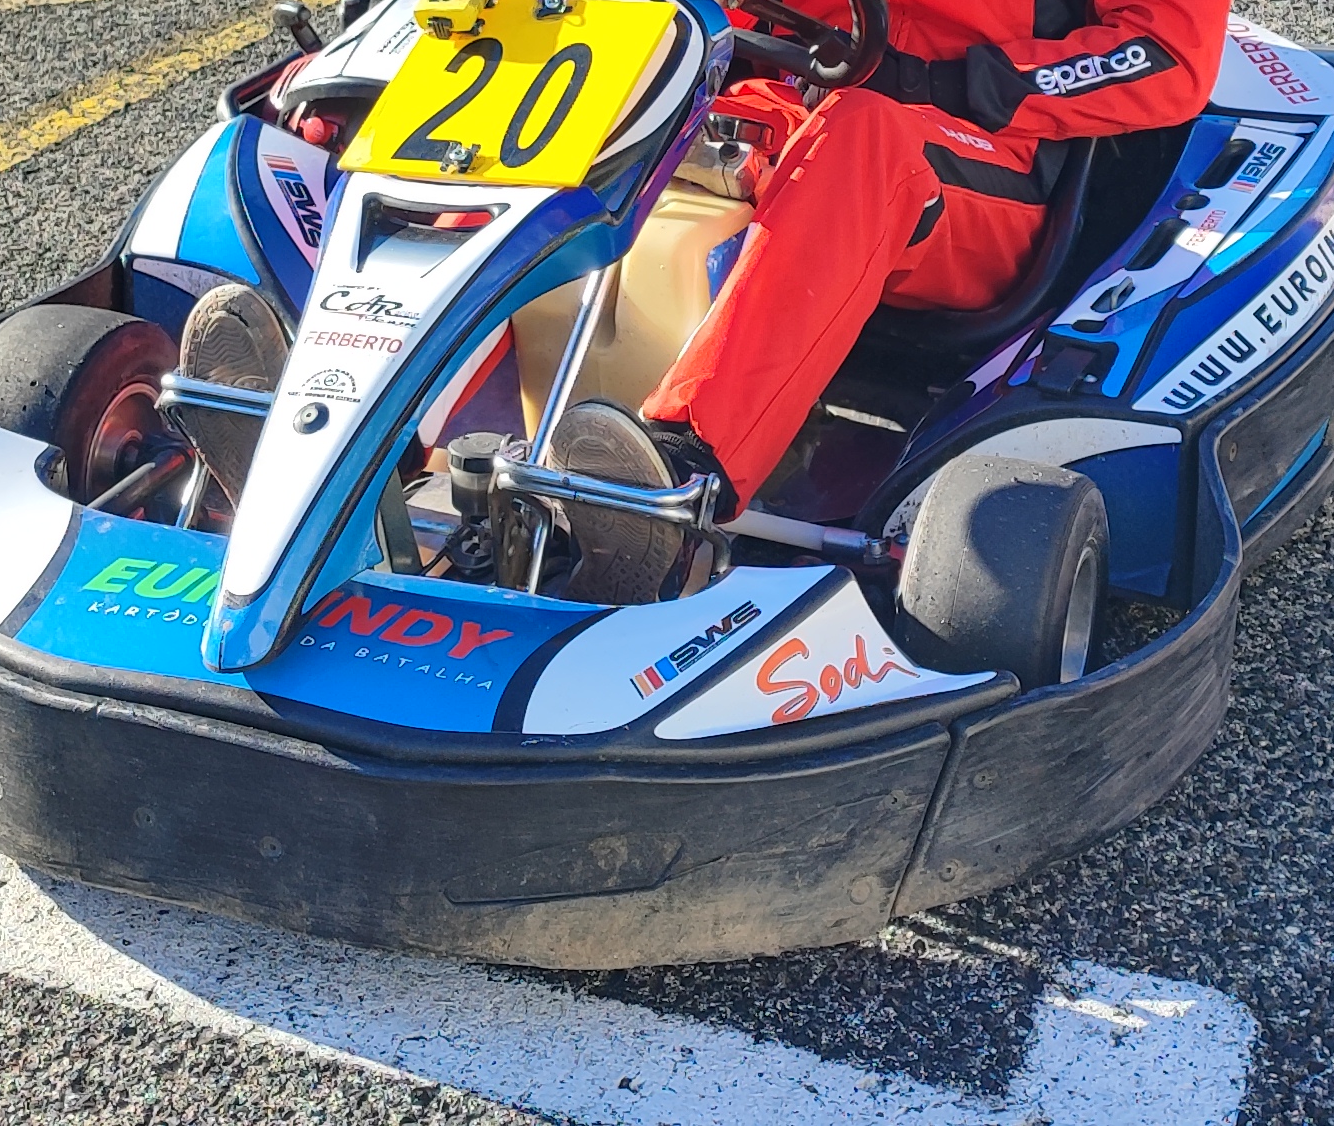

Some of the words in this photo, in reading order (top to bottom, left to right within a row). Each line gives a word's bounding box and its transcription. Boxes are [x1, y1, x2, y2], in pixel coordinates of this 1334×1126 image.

[1035, 45, 1151, 95] sparco
[1227, 23, 1320, 105] FERBERTO
[391, 37, 593, 168] 20
[304, 331, 403, 354] FERBERTO
[300, 625, 336, 651] DA
[354, 647, 493, 690] BATALHA
[757, 635, 920, 724] Sodi
